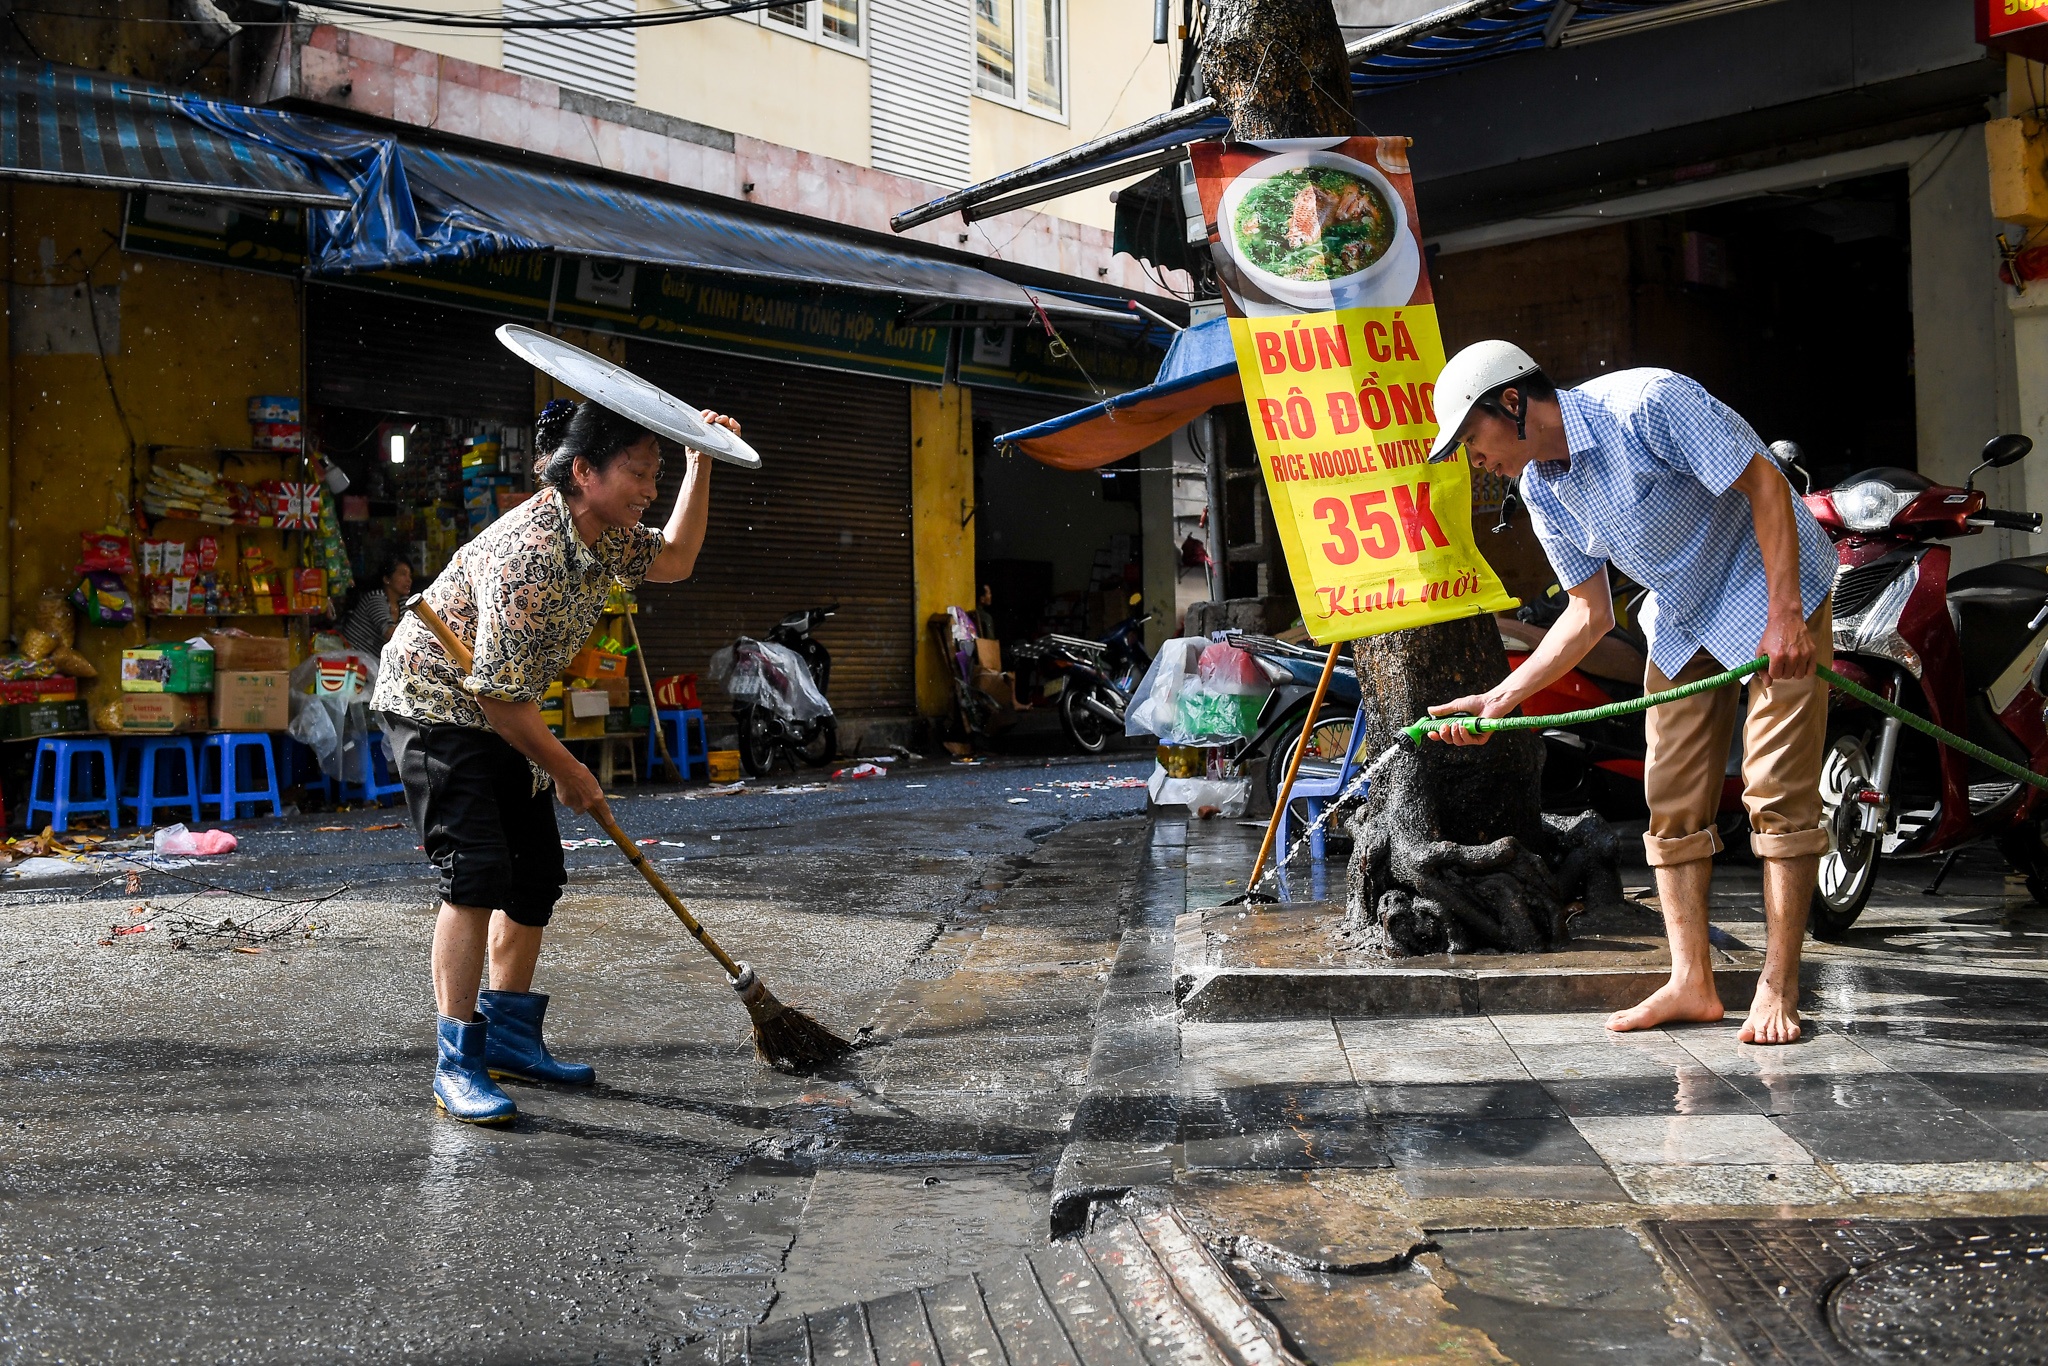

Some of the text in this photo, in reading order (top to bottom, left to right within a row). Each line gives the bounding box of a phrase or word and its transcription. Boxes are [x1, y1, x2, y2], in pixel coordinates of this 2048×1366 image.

[697, 287, 739, 319] KINH
[742, 294, 798, 329] DOANH
[1255, 311, 1420, 374] BÚN CÁ
[1257, 387, 1317, 441] RÔ
[1270, 454, 1309, 482] RICE
[1309, 446, 1377, 479] NOODLE
[1378, 438, 1427, 470] WITH
[1313, 482, 1450, 565] 35K
[1420, 567, 1482, 603] mời
